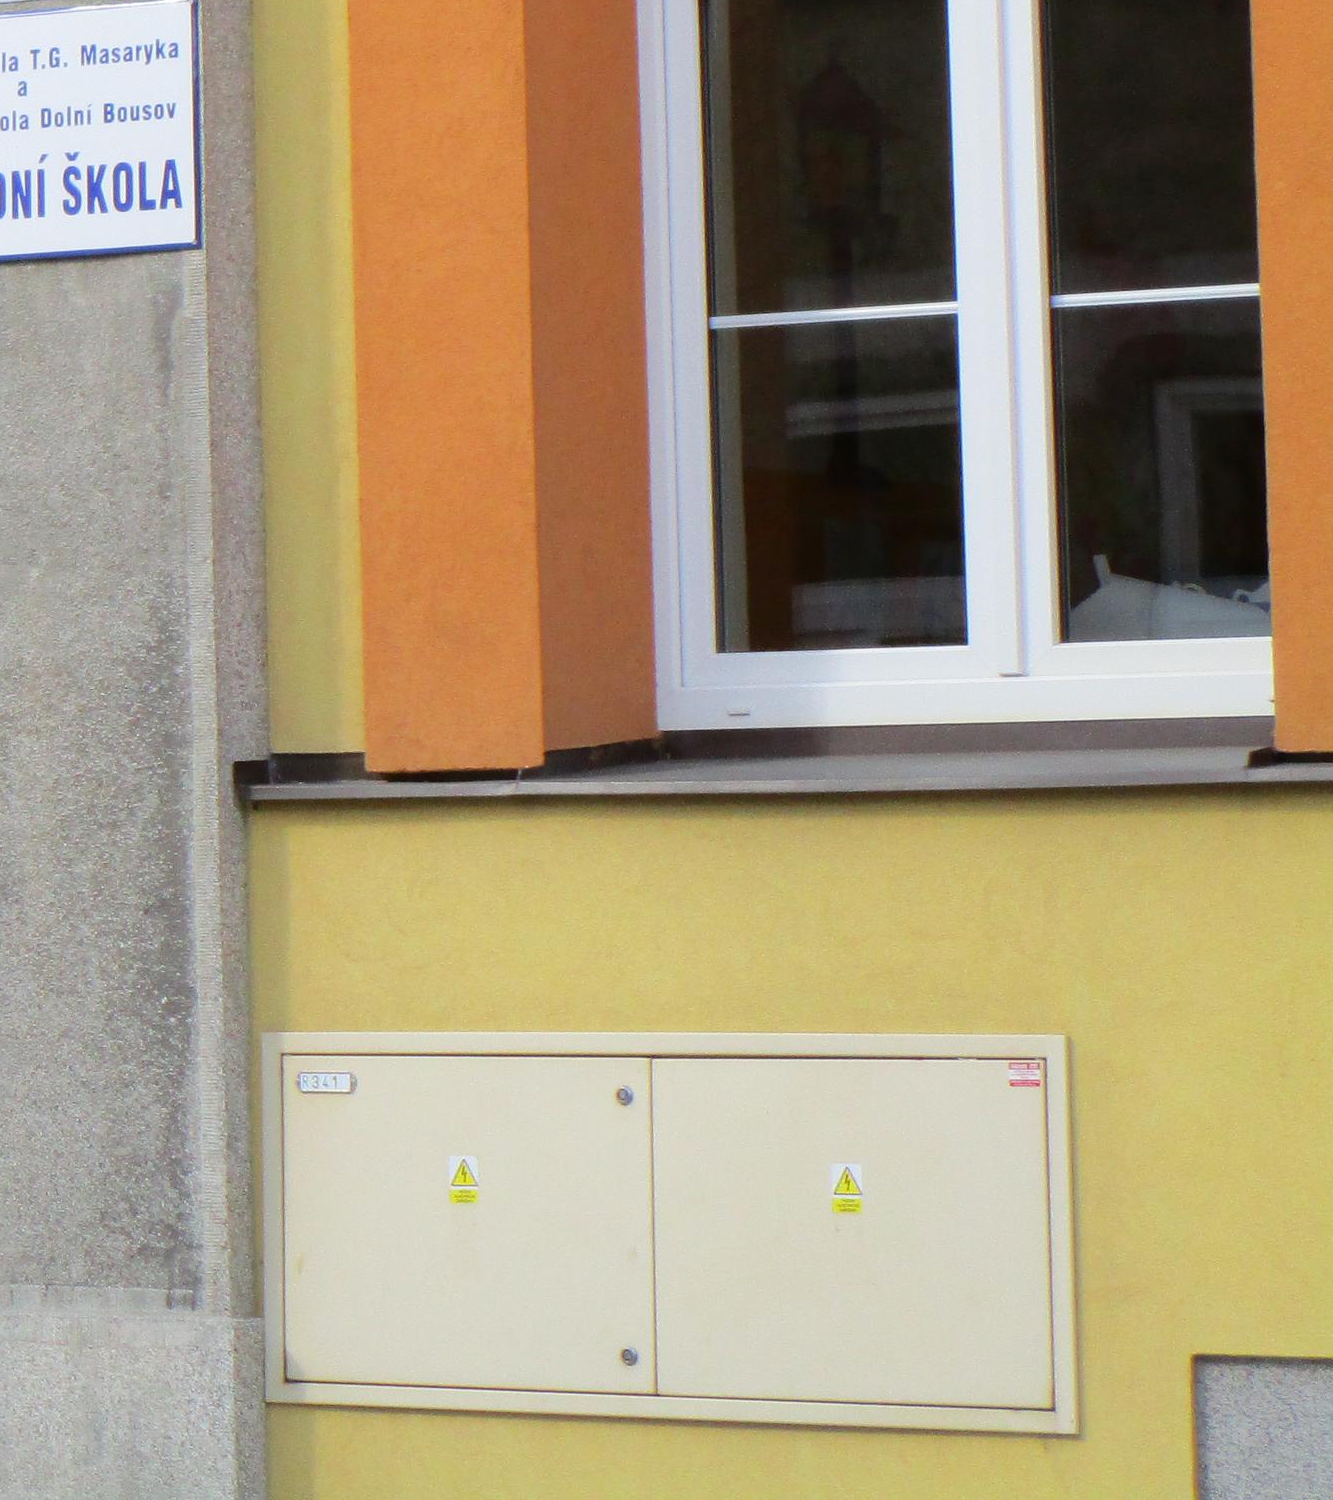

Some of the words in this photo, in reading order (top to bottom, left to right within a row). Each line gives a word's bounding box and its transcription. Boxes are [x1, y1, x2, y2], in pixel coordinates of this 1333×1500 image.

[80, 39, 180, 66] Masaryka
[17, 81, 27, 96] a
[40, 104, 92, 128] Dolní
[102, 102, 177, 124] Bousov
[62, 151, 183, 216] ŠKOLA
